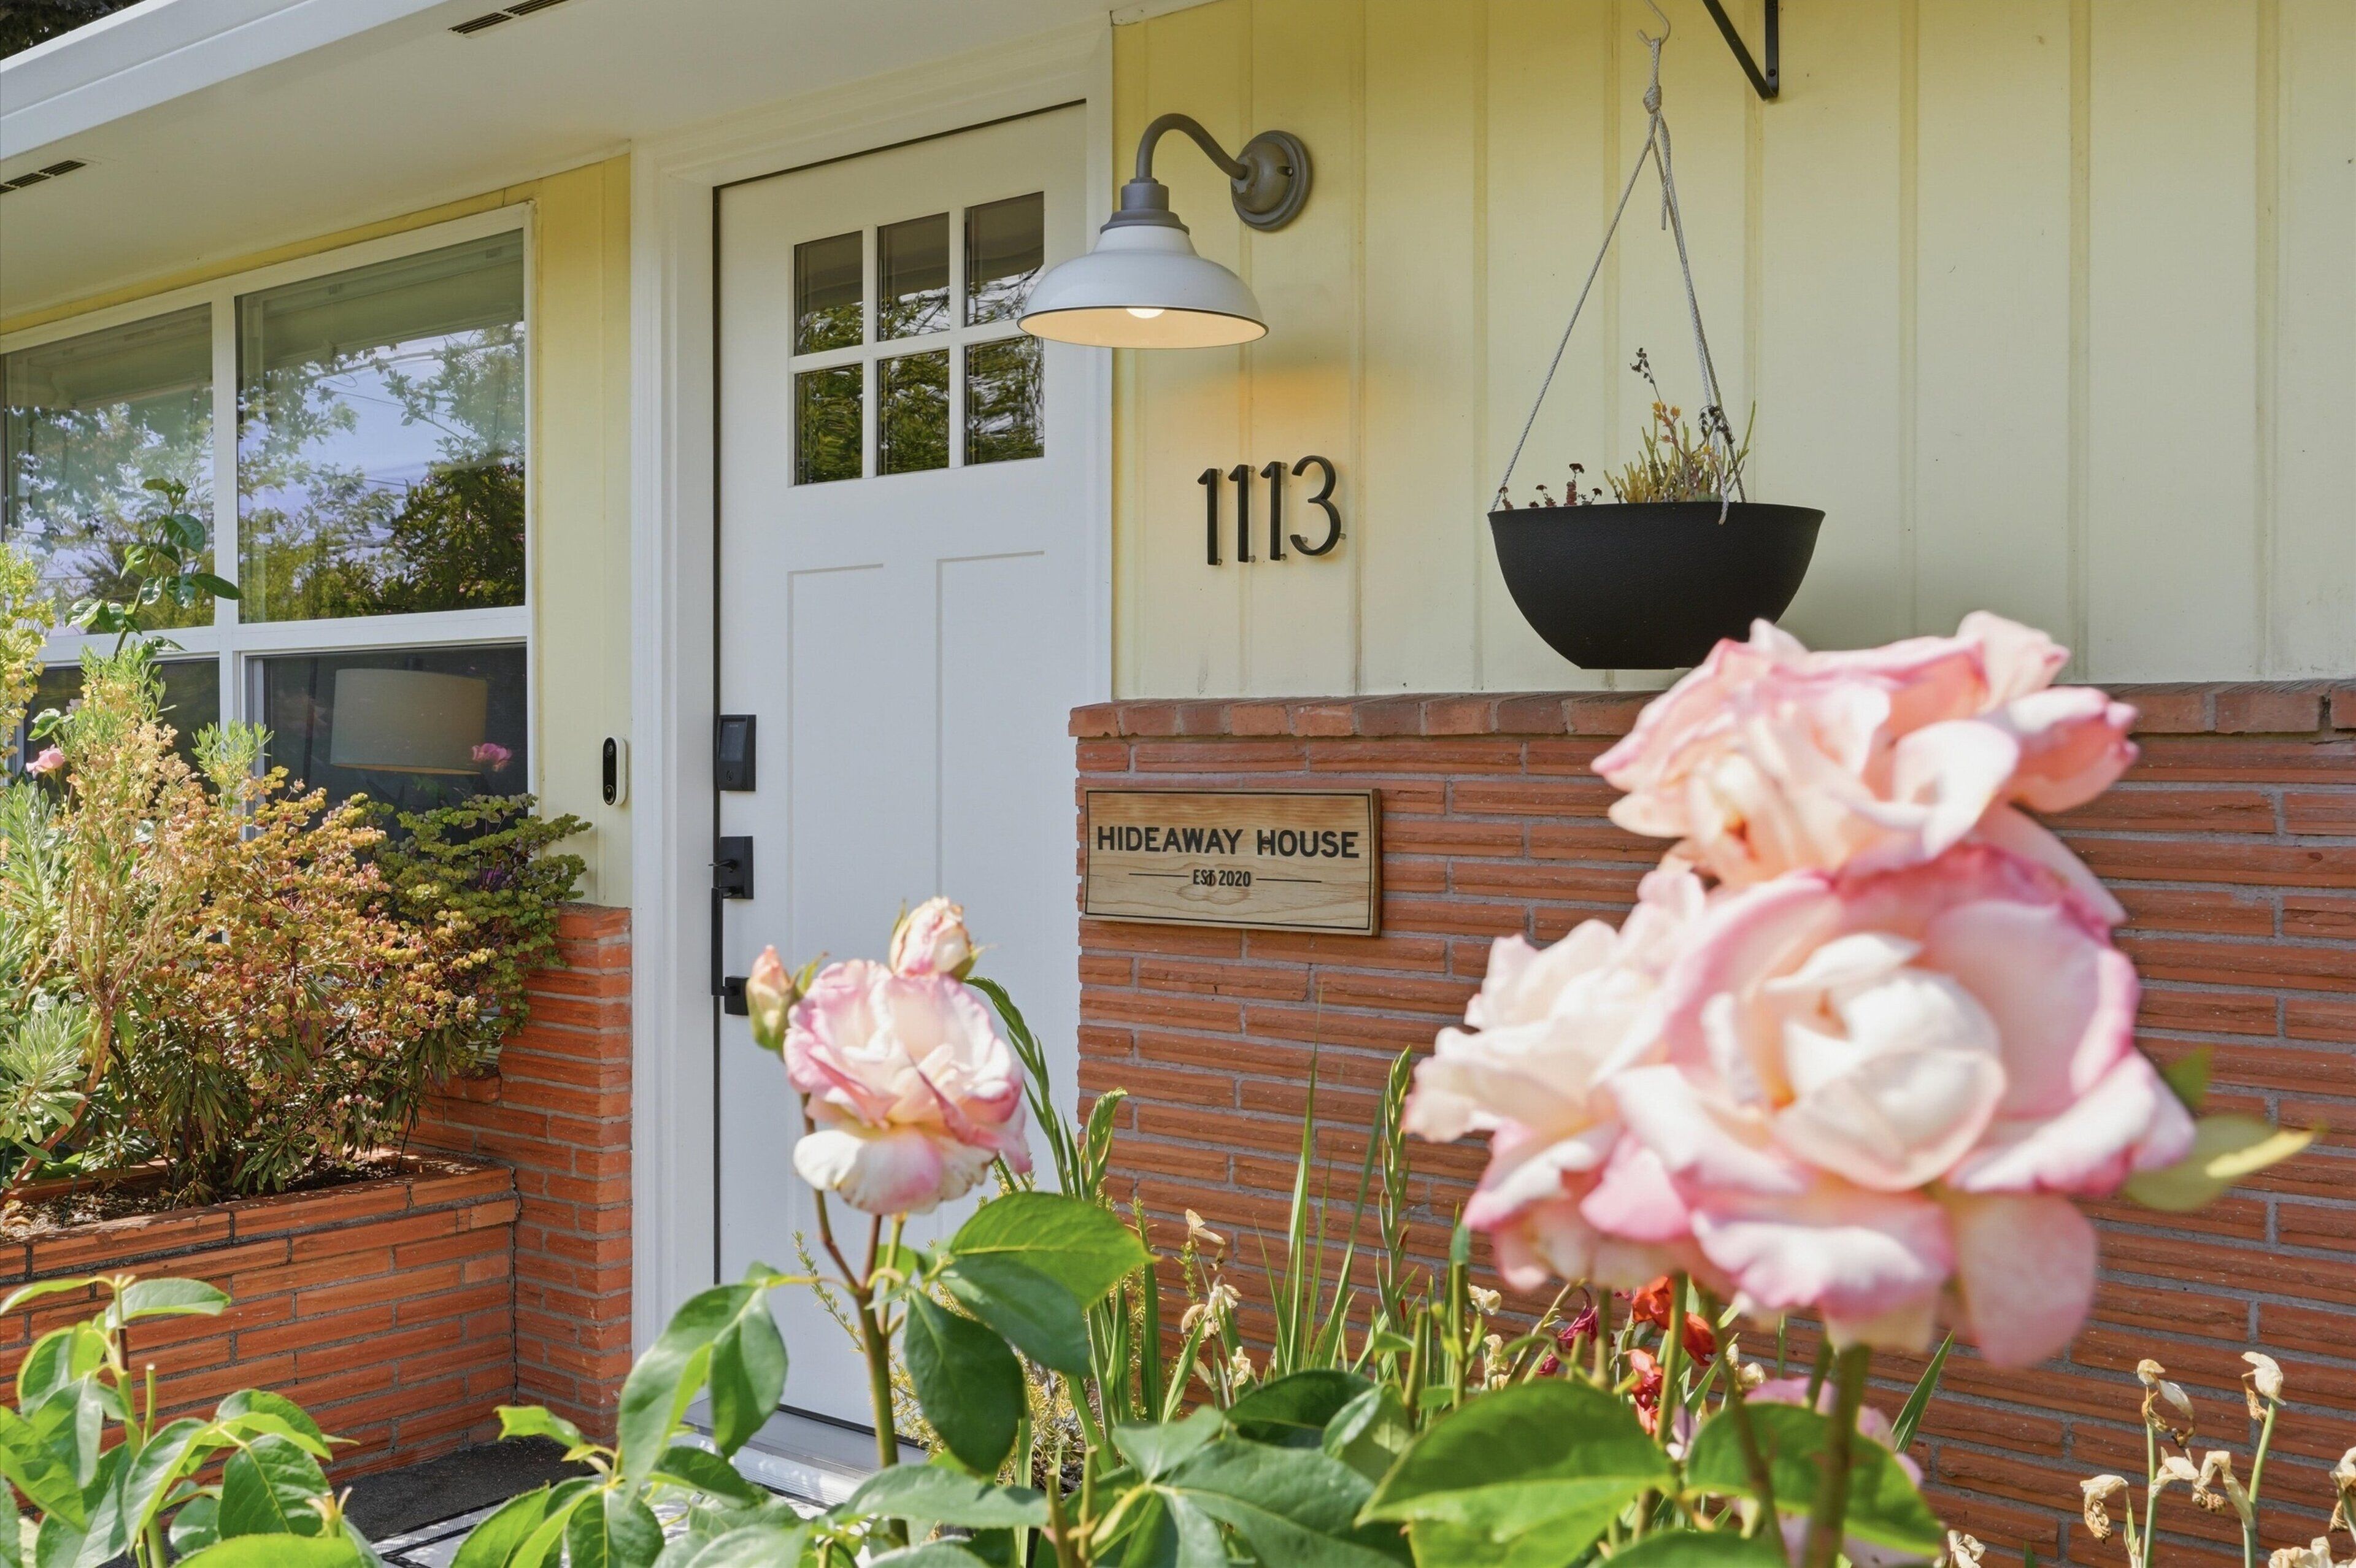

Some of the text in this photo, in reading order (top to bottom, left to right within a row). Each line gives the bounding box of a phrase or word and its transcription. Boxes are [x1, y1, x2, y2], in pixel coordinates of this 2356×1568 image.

[1197, 455, 1341, 565] 1113
[1098, 826, 1359, 858] HIDEAWAY HOUSE
[1218, 870, 1251, 887] 2020
